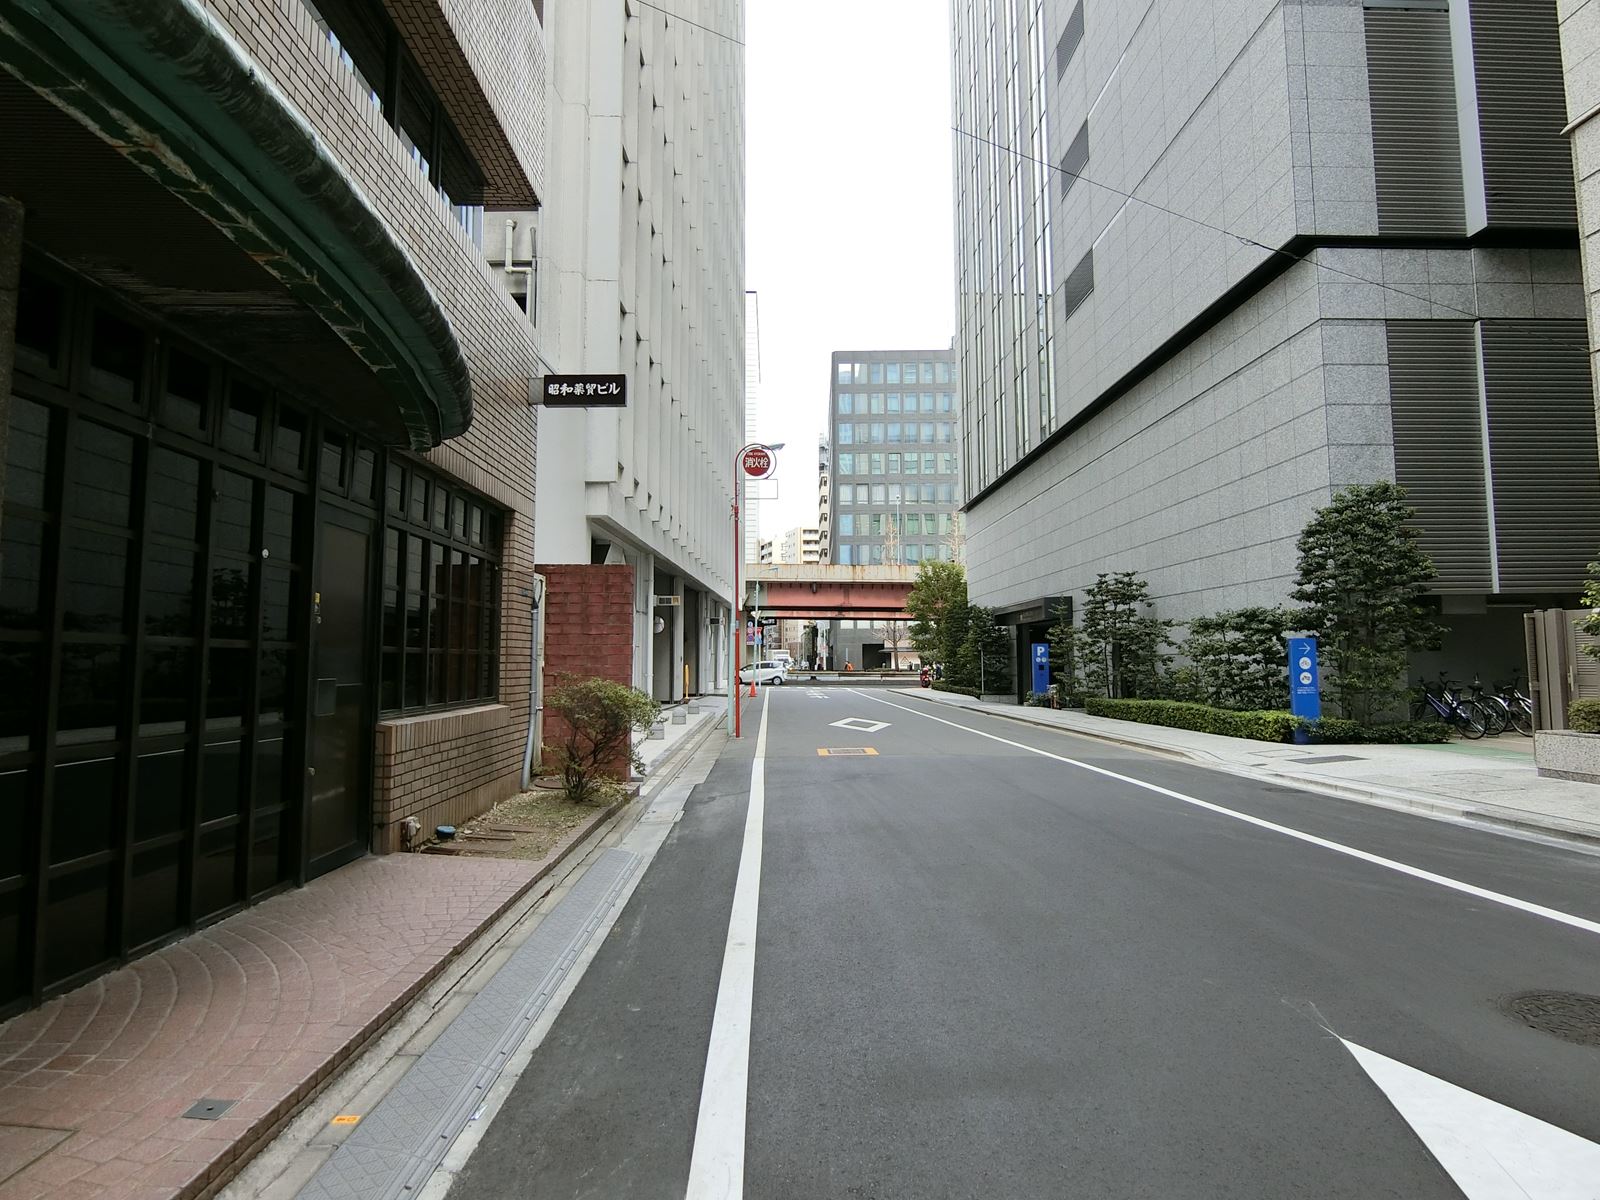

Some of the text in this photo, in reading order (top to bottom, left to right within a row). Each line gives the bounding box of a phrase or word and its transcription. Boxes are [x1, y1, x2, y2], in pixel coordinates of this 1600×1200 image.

[548, 382, 620, 396] 昭和薬貿ビル
[745, 457, 768, 468] 消火栓
[1037, 647, 1045, 656] P
